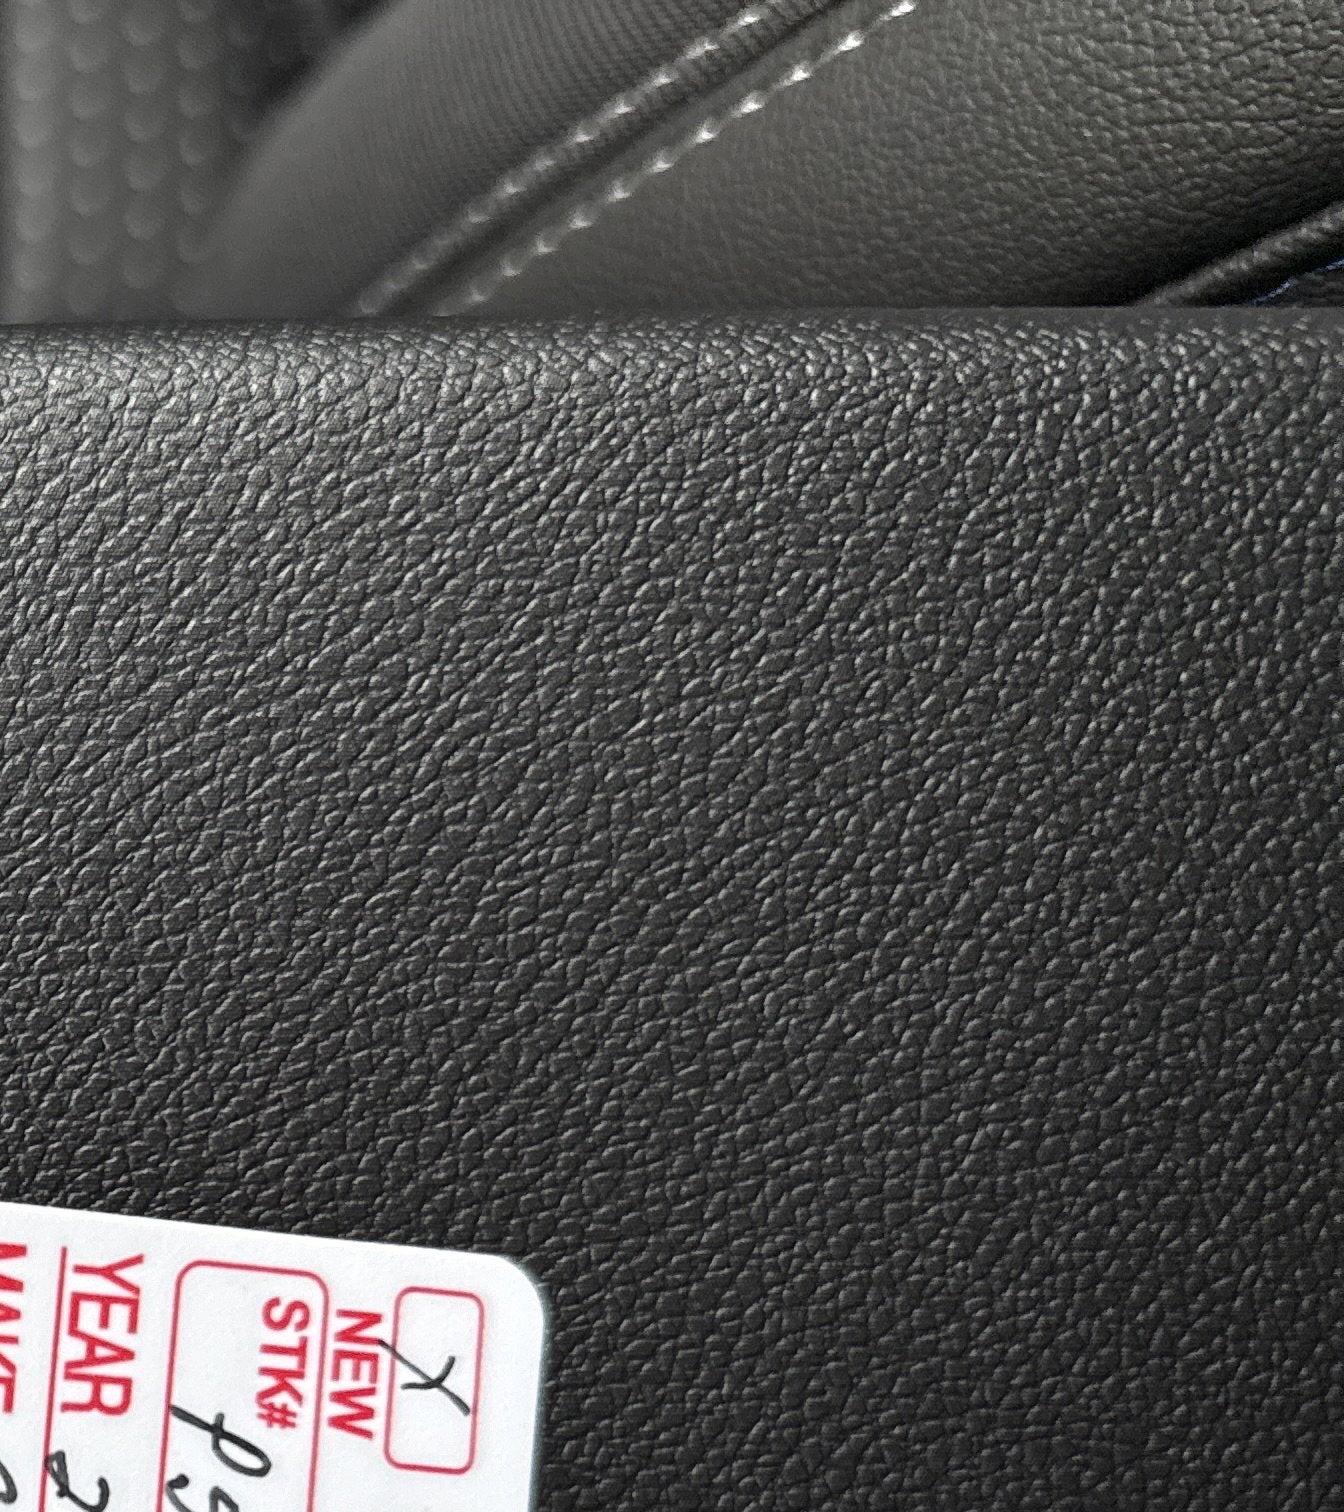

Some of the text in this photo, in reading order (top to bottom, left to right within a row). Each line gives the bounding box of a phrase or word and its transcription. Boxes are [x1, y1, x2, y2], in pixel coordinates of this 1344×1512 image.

[61, 1253, 145, 1417] YEAR
[255, 1296, 312, 1430] STK#
[326, 1308, 384, 1440] NEW
